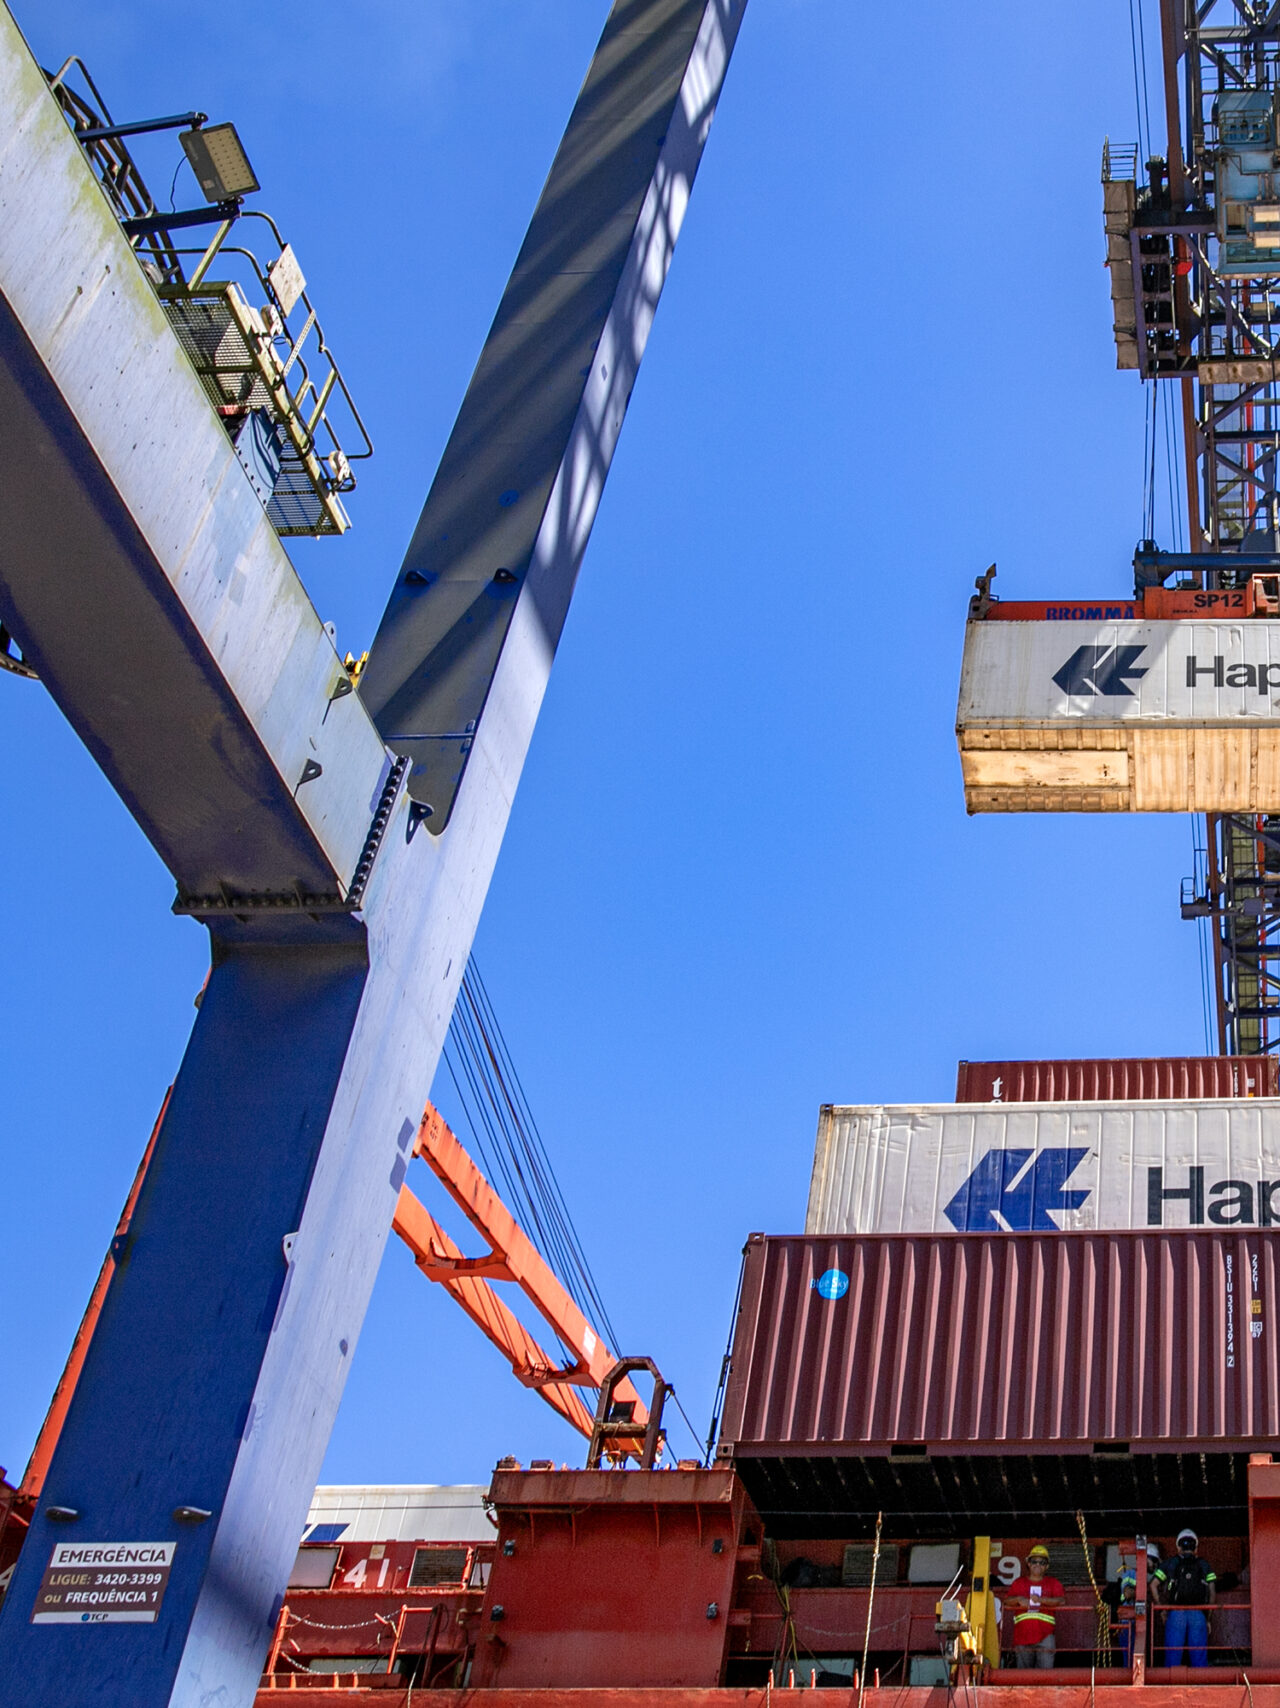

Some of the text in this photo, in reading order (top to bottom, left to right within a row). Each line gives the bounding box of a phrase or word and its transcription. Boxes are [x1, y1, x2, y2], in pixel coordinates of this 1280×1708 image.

[1194, 594, 1243, 608] SP12
[1046, 607, 1135, 620] BROMMA
[809, 1277, 849, 1289] Blue Sky
[1227, 1355, 1235, 1367] 2
[58, 1546, 166, 1563] EMERGÊNCIA
[49, 1573, 162, 1585] LIGUE: 3420-3399
[344, 1559, 390, 1588] 41
[44, 1589, 158, 1604] ou FREQUÊNCIA 1
[90, 1613, 109, 1621] TCP
